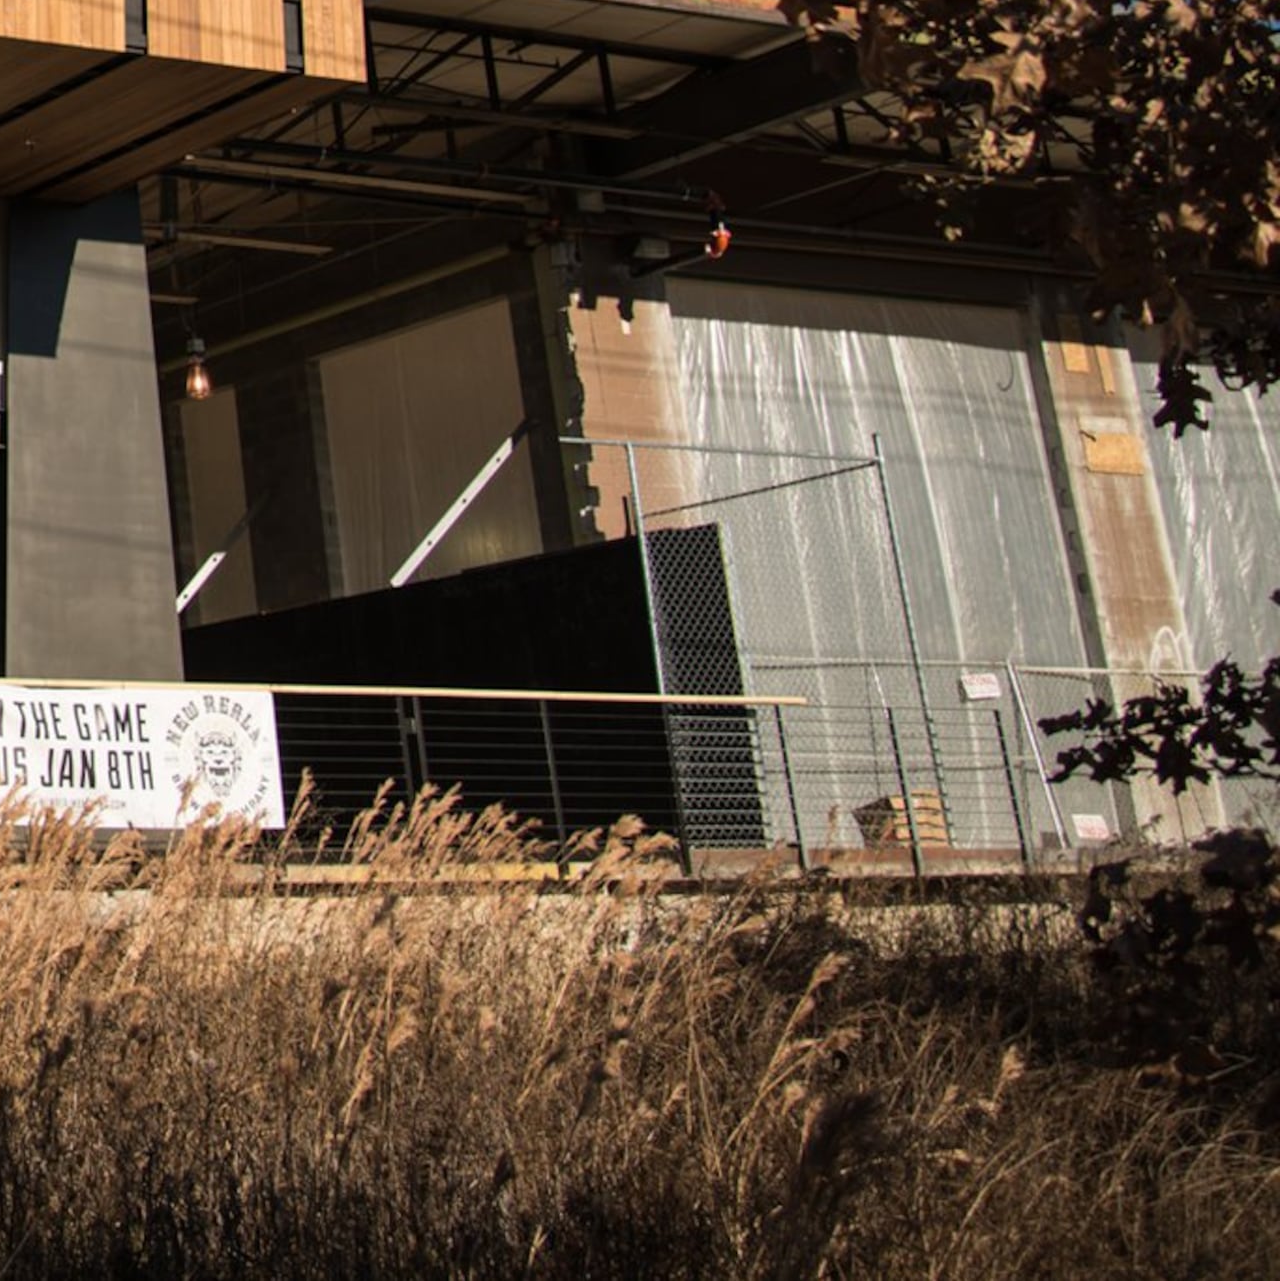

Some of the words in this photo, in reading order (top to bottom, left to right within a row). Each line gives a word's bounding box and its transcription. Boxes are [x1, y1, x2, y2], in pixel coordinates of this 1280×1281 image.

[13, 701, 67, 740] THE
[73, 703, 150, 743] GAME
[40, 748, 96, 789] JAN
[107, 750, 154, 790] 8TH
